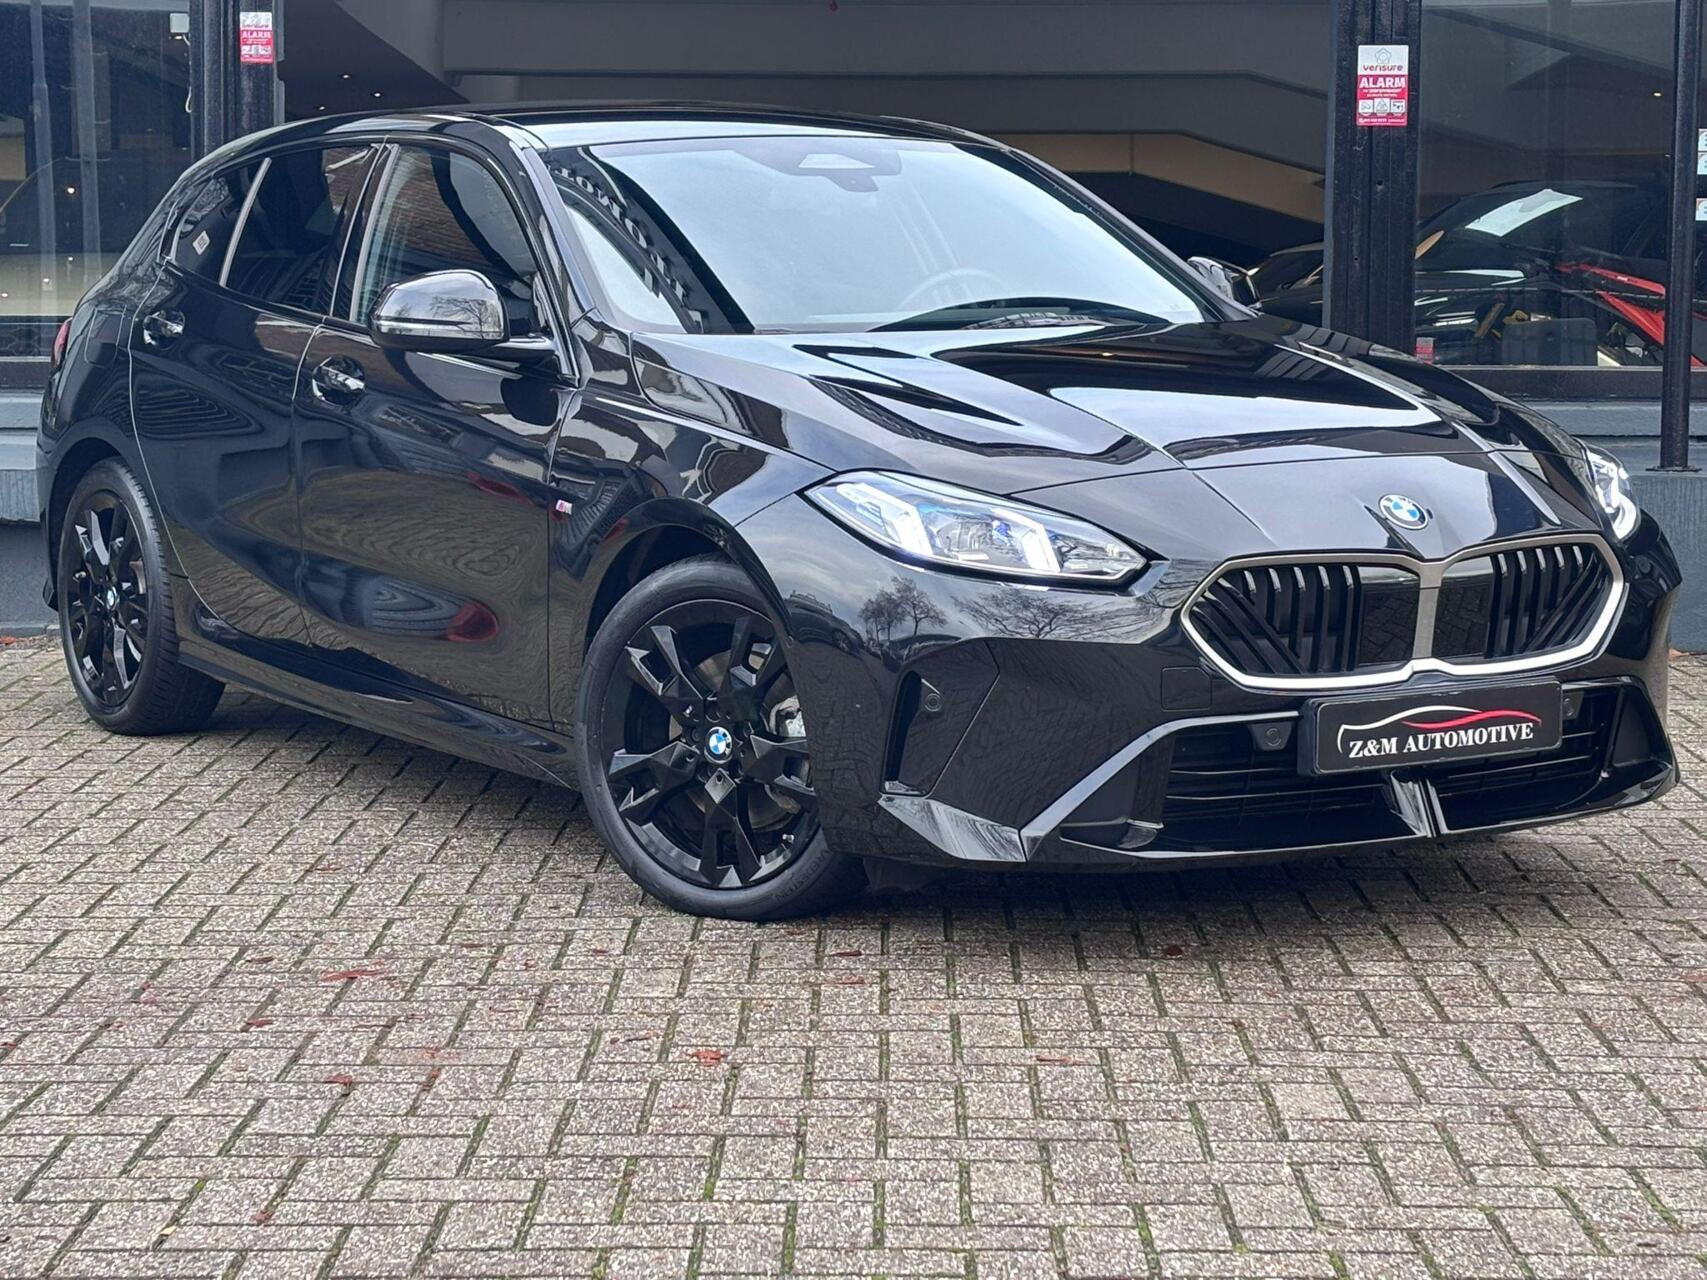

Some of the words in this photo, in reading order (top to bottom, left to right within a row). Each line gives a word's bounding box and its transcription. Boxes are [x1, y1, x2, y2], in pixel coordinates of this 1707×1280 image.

[1362, 64, 1404, 72] verisure
[1359, 77, 1406, 88] ALARM
[1348, 736, 1398, 758] Z&M
[1402, 722, 1534, 753] AUTOMOTIVE
